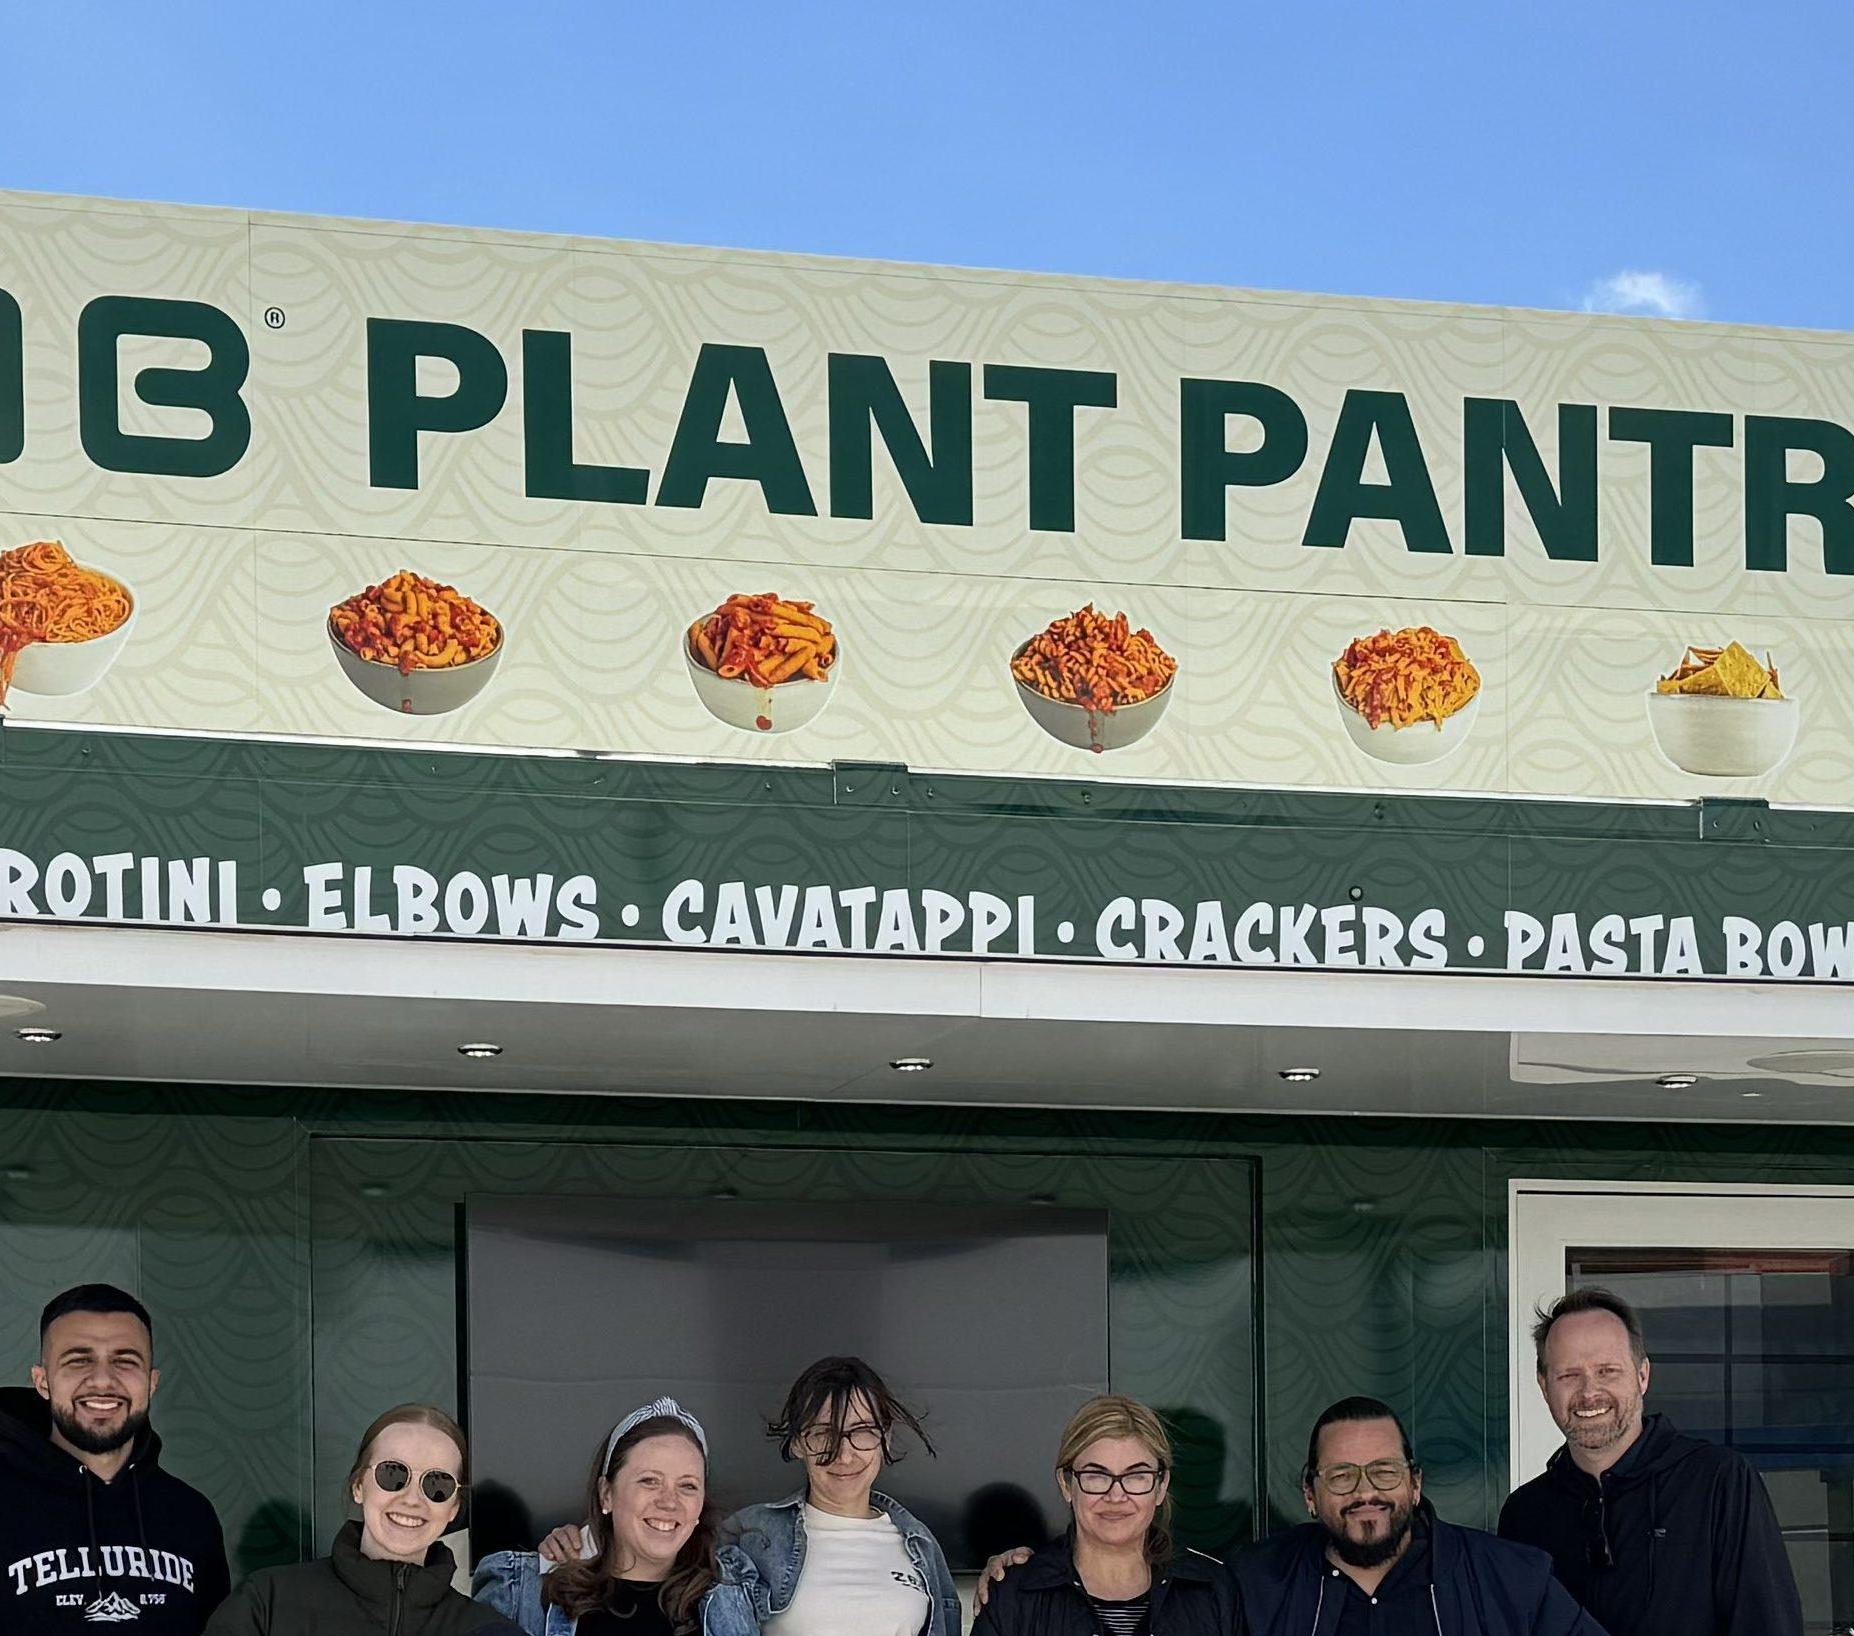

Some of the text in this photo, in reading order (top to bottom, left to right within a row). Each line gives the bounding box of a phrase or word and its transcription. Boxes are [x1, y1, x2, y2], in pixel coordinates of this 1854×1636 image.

[367, 317, 1117, 532] PLANT
[304, 863, 599, 940] ELBOWS
[662, 879, 1035, 954] CAVATAPPI
[1096, 896, 1448, 967] CRACKERS
[1505, 910, 1700, 976] PASTA
[8, 1546, 194, 1596] TELLURIDE
